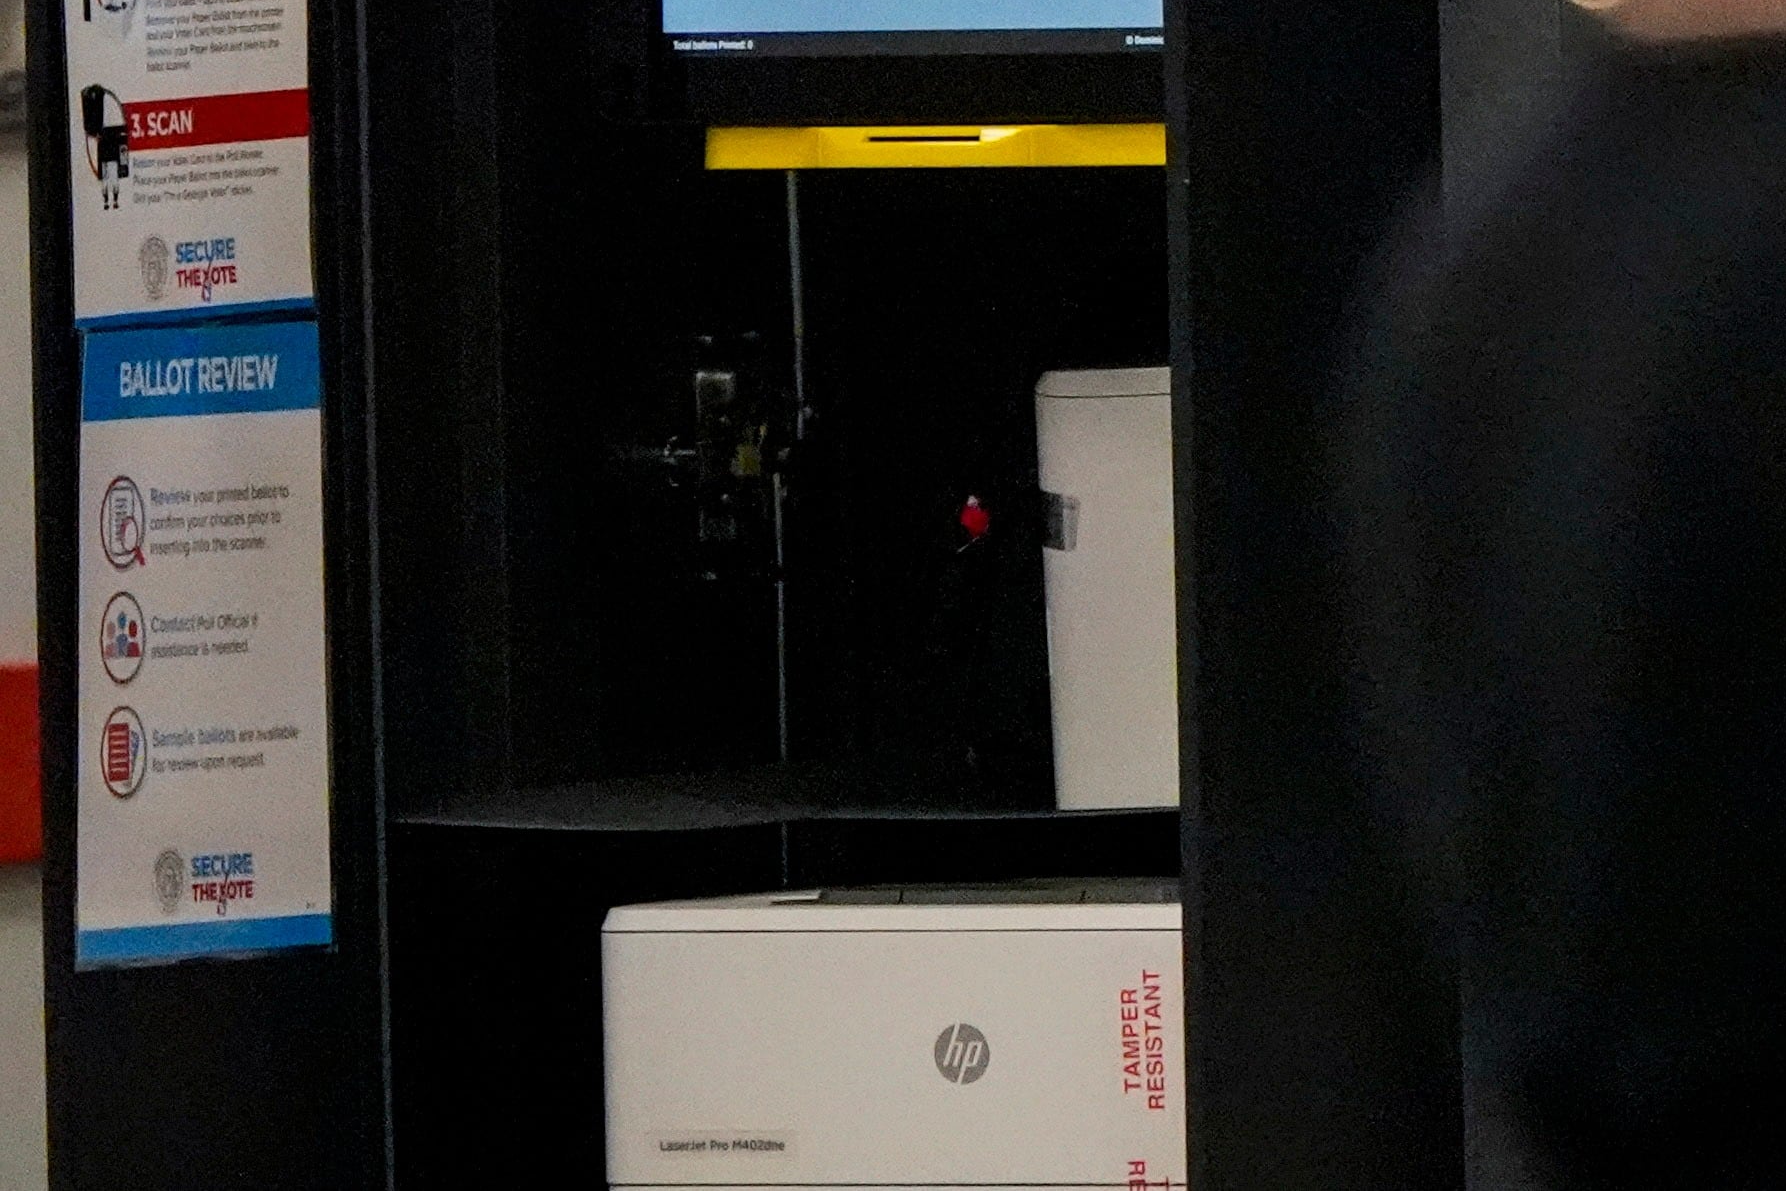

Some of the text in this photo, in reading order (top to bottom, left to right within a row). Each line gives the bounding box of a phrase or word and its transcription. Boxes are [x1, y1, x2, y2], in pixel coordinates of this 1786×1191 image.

[131, 109, 193, 139] 3. SCAN
[175, 237, 236, 265] SECURE
[119, 354, 279, 398] BALLOT REVIEW
[191, 852, 254, 879] SECURE
[940, 1022, 988, 1085] hp
[1120, 988, 1142, 1094] TAMPER
[1142, 969, 1165, 1110] RESISTANT
[660, 1139, 706, 1152] LaserJet
[710, 1139, 729, 1151] Pro
